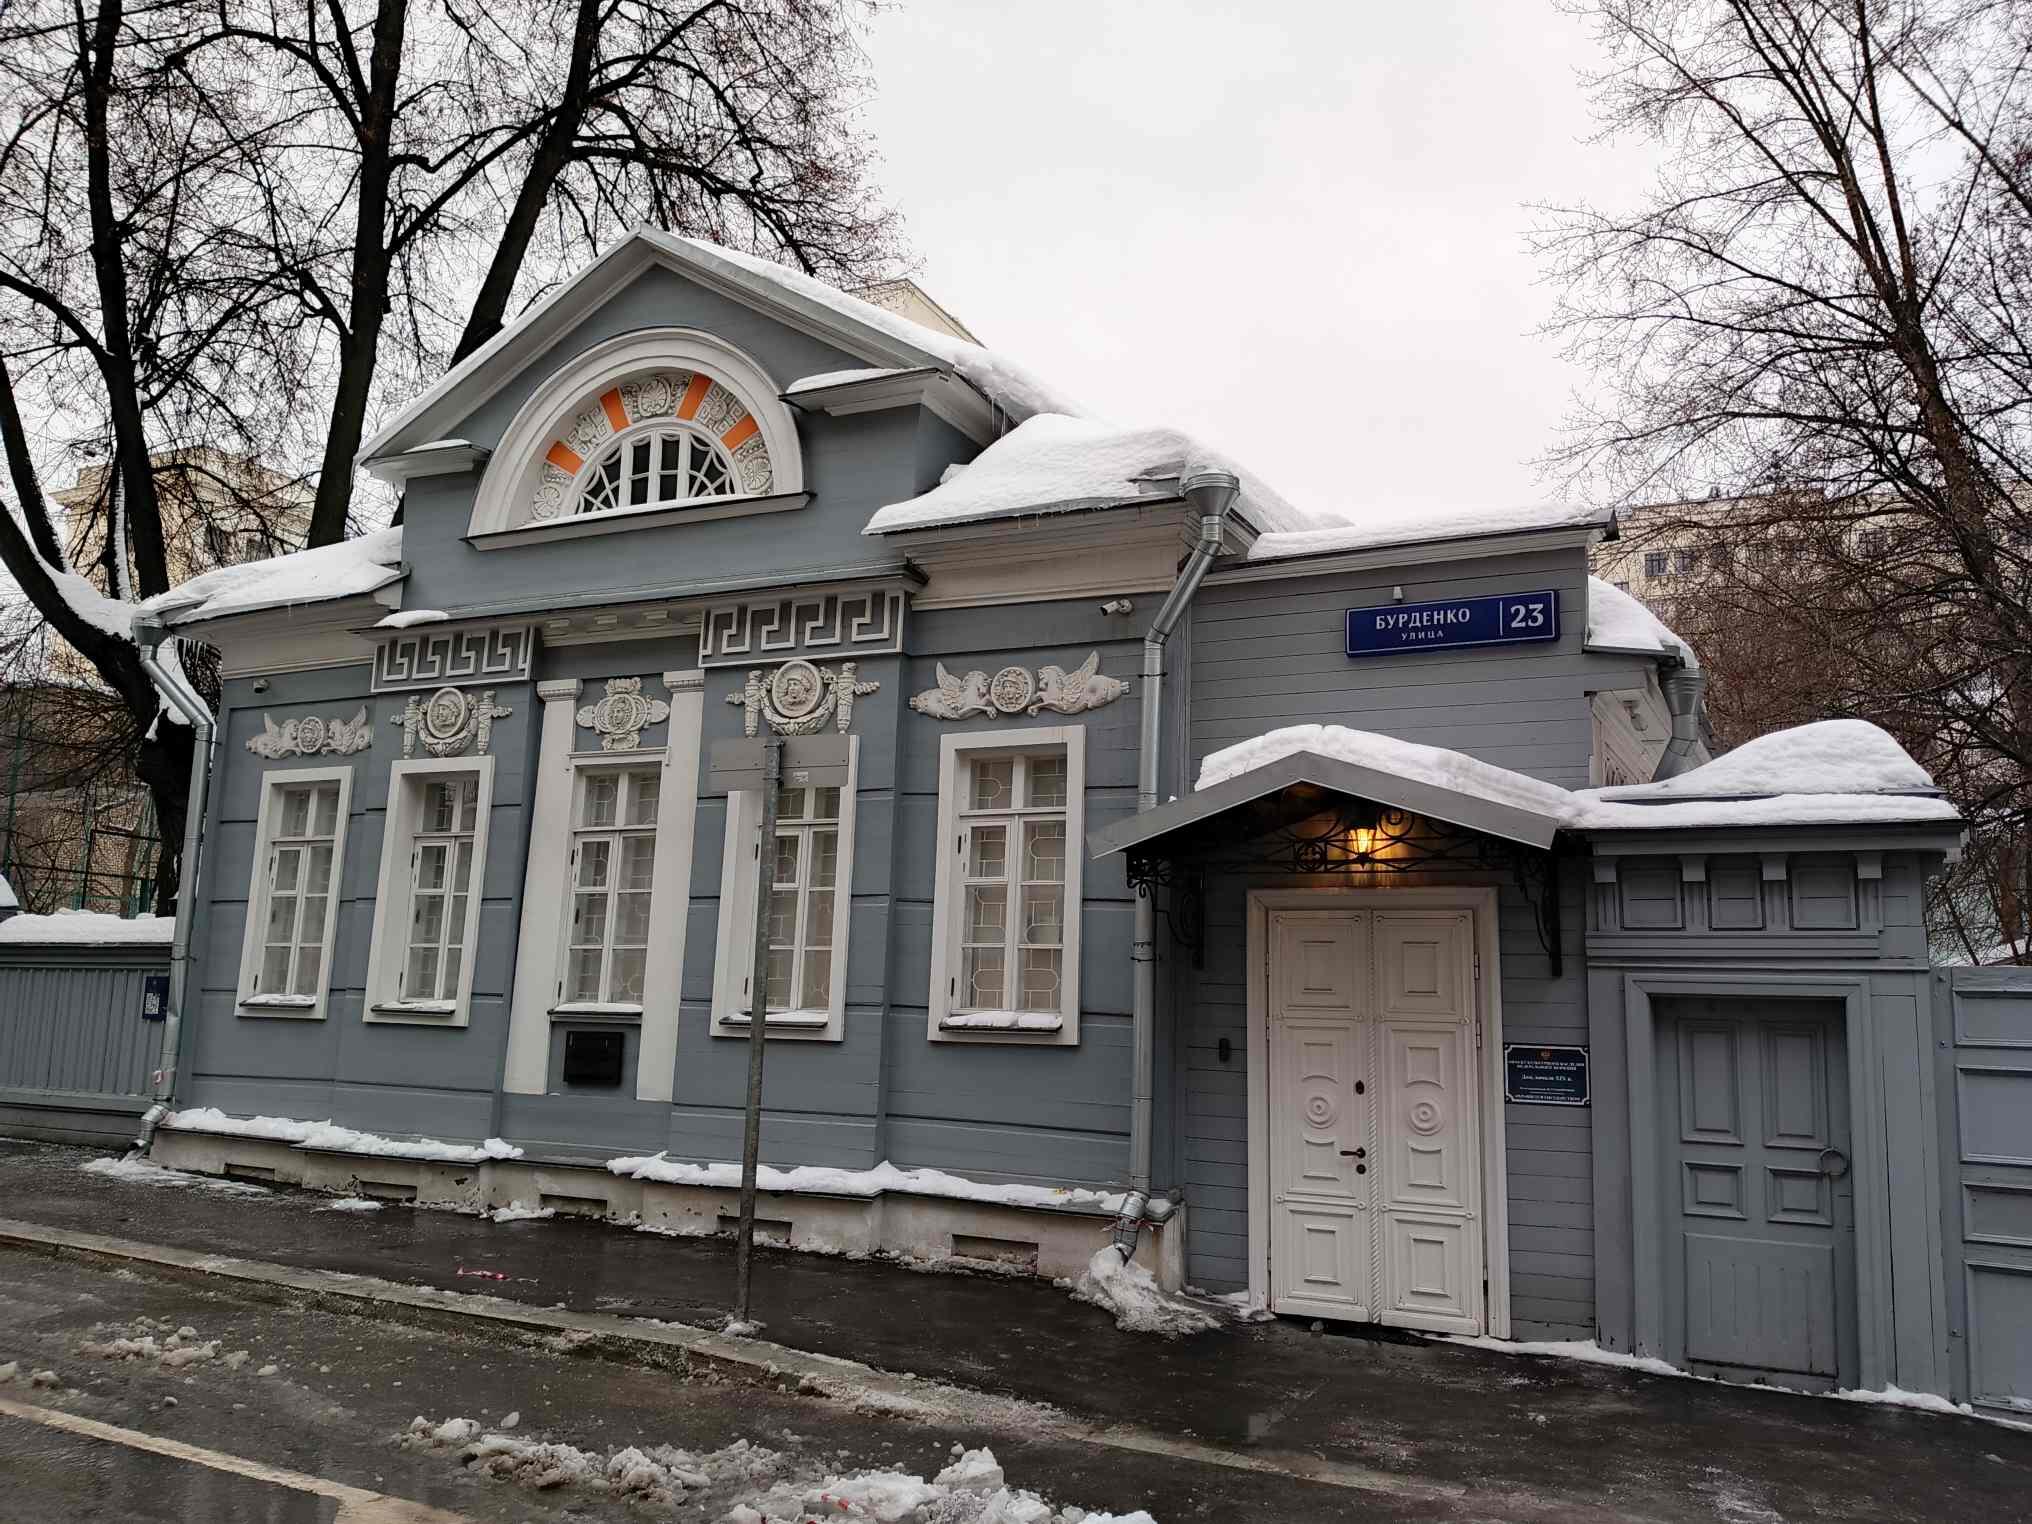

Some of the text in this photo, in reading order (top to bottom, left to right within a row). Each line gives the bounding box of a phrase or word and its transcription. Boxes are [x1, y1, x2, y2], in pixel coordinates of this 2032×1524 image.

[1376, 608, 1470, 630] БУРДЕНКО
[1510, 604, 1544, 628] 23
[1401, 629, 1444, 641] УЛИЦА
